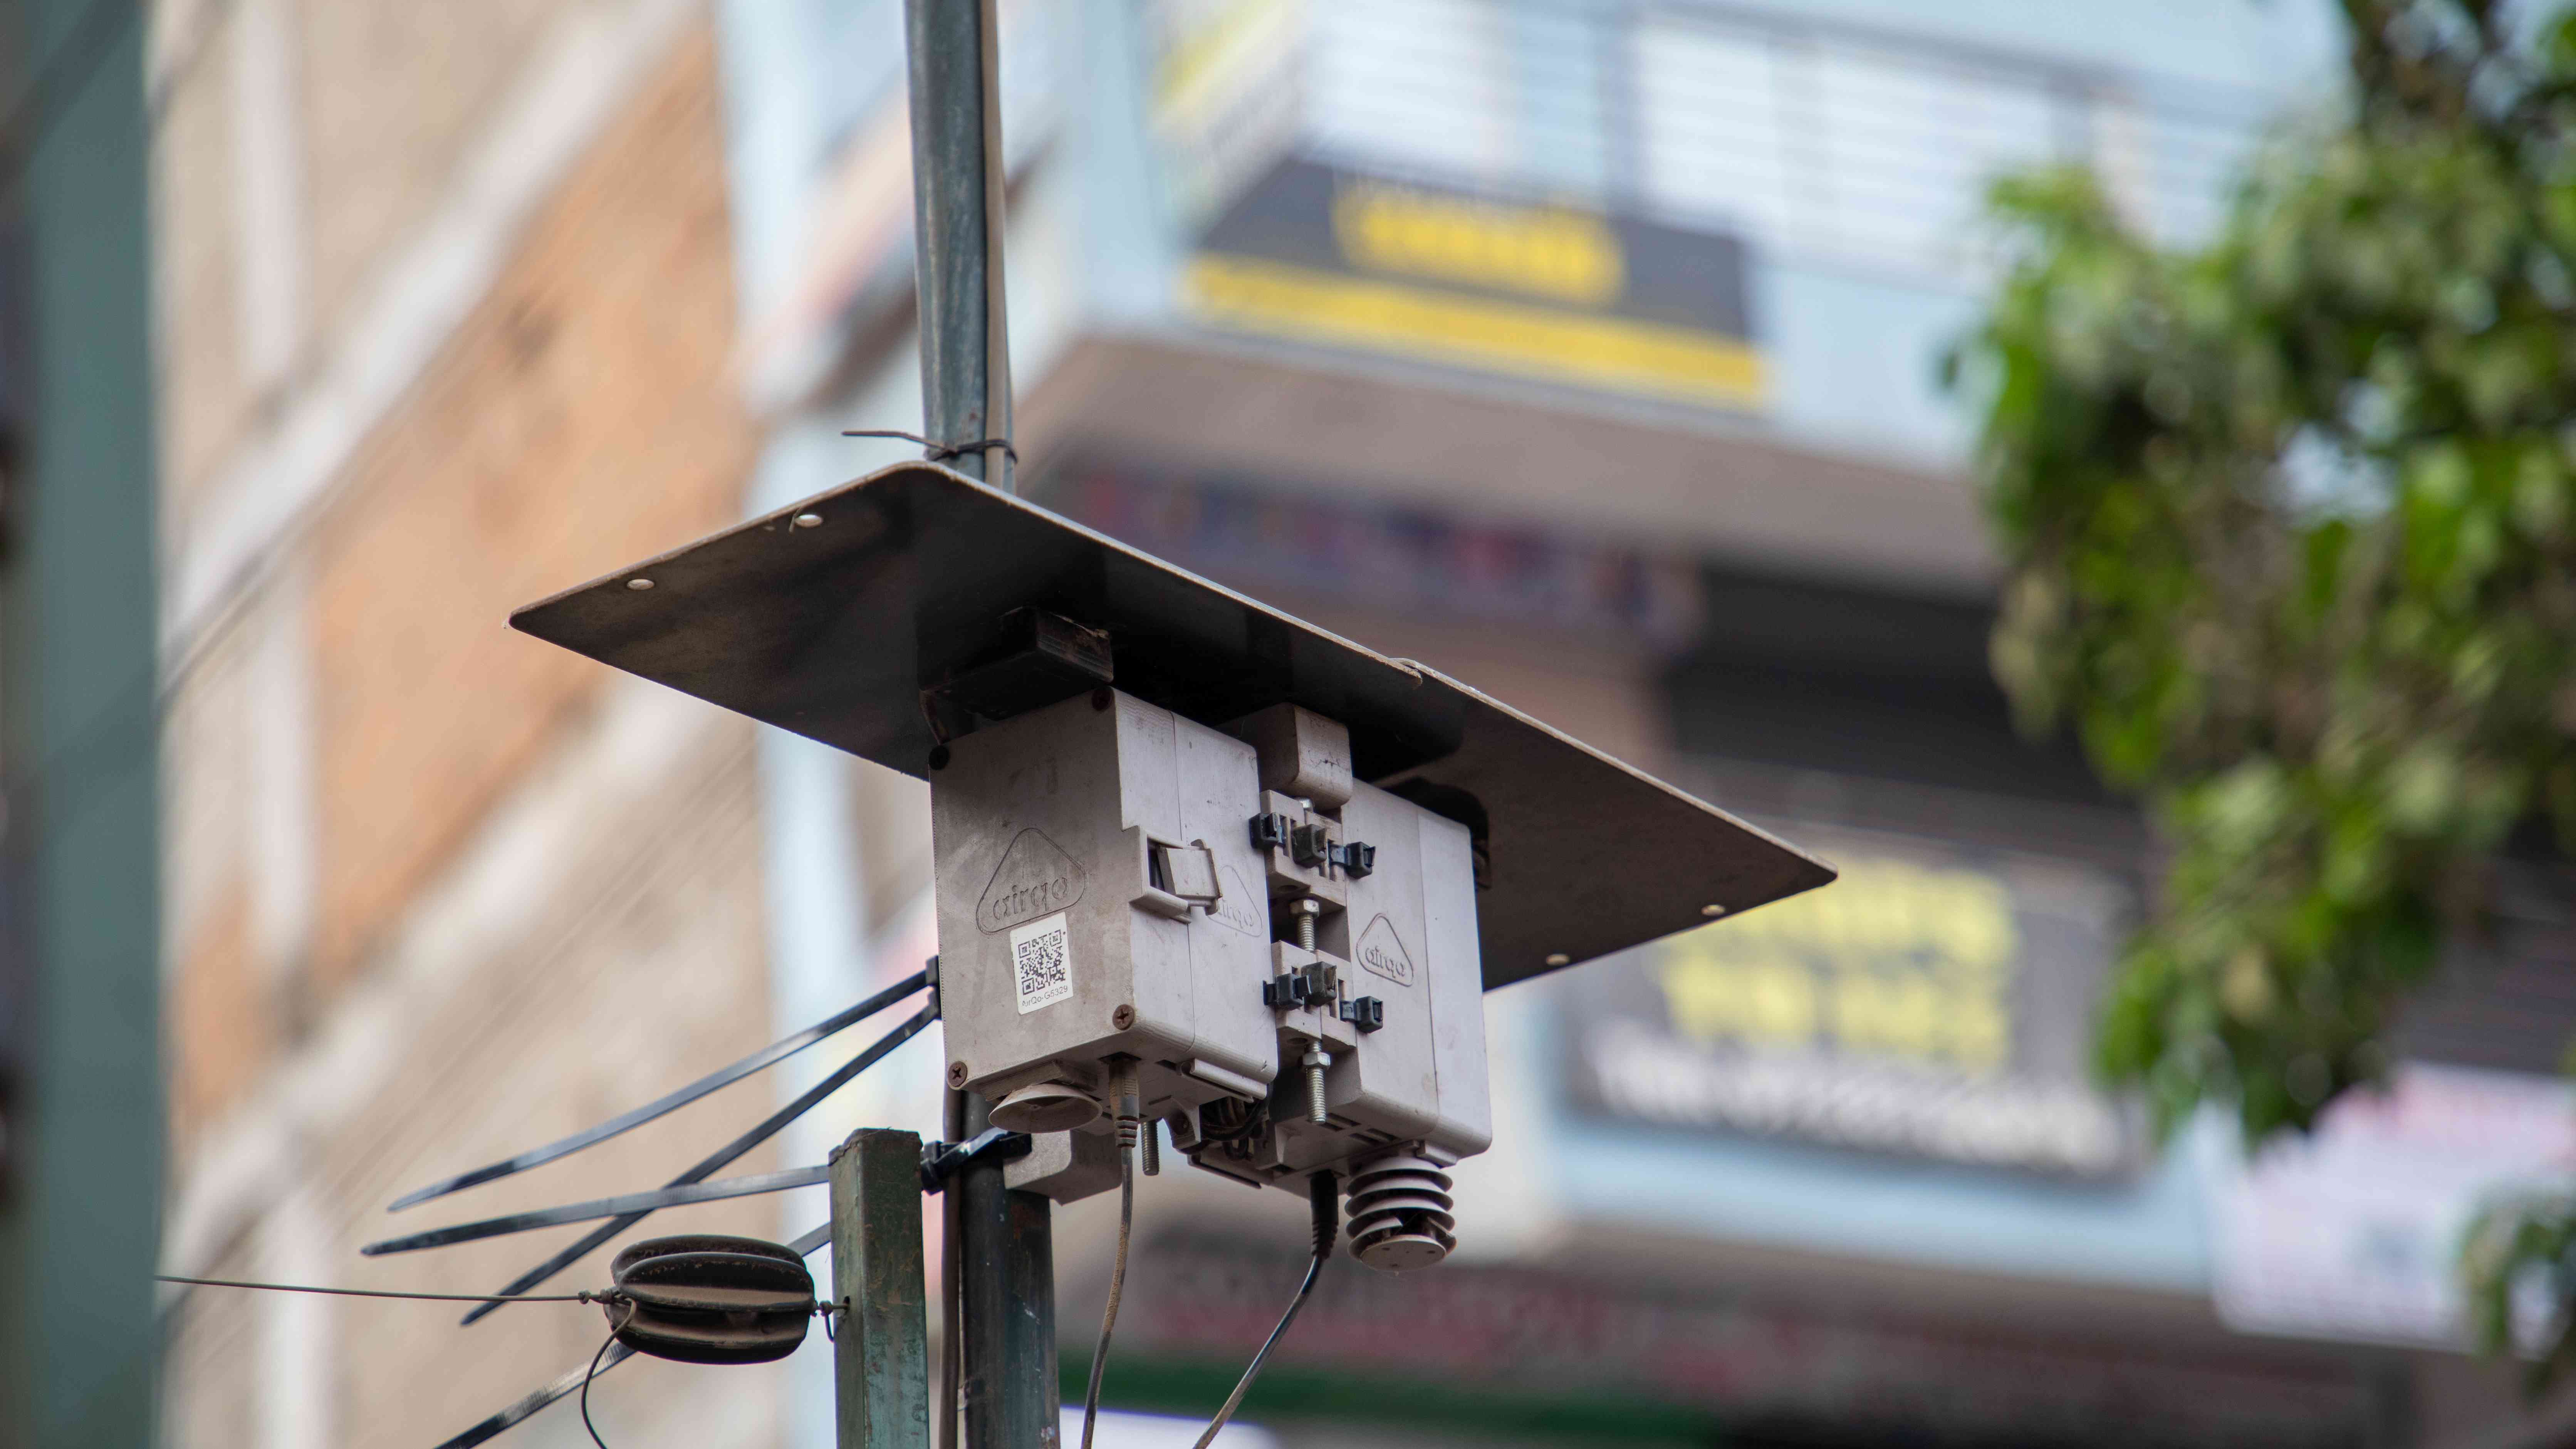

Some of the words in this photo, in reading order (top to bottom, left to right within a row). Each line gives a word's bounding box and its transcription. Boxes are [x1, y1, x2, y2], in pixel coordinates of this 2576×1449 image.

[993, 877, 1067, 920] airqo
[1365, 945, 1405, 979] airqo
[1022, 985, 1068, 1007] AirQo-G5329
